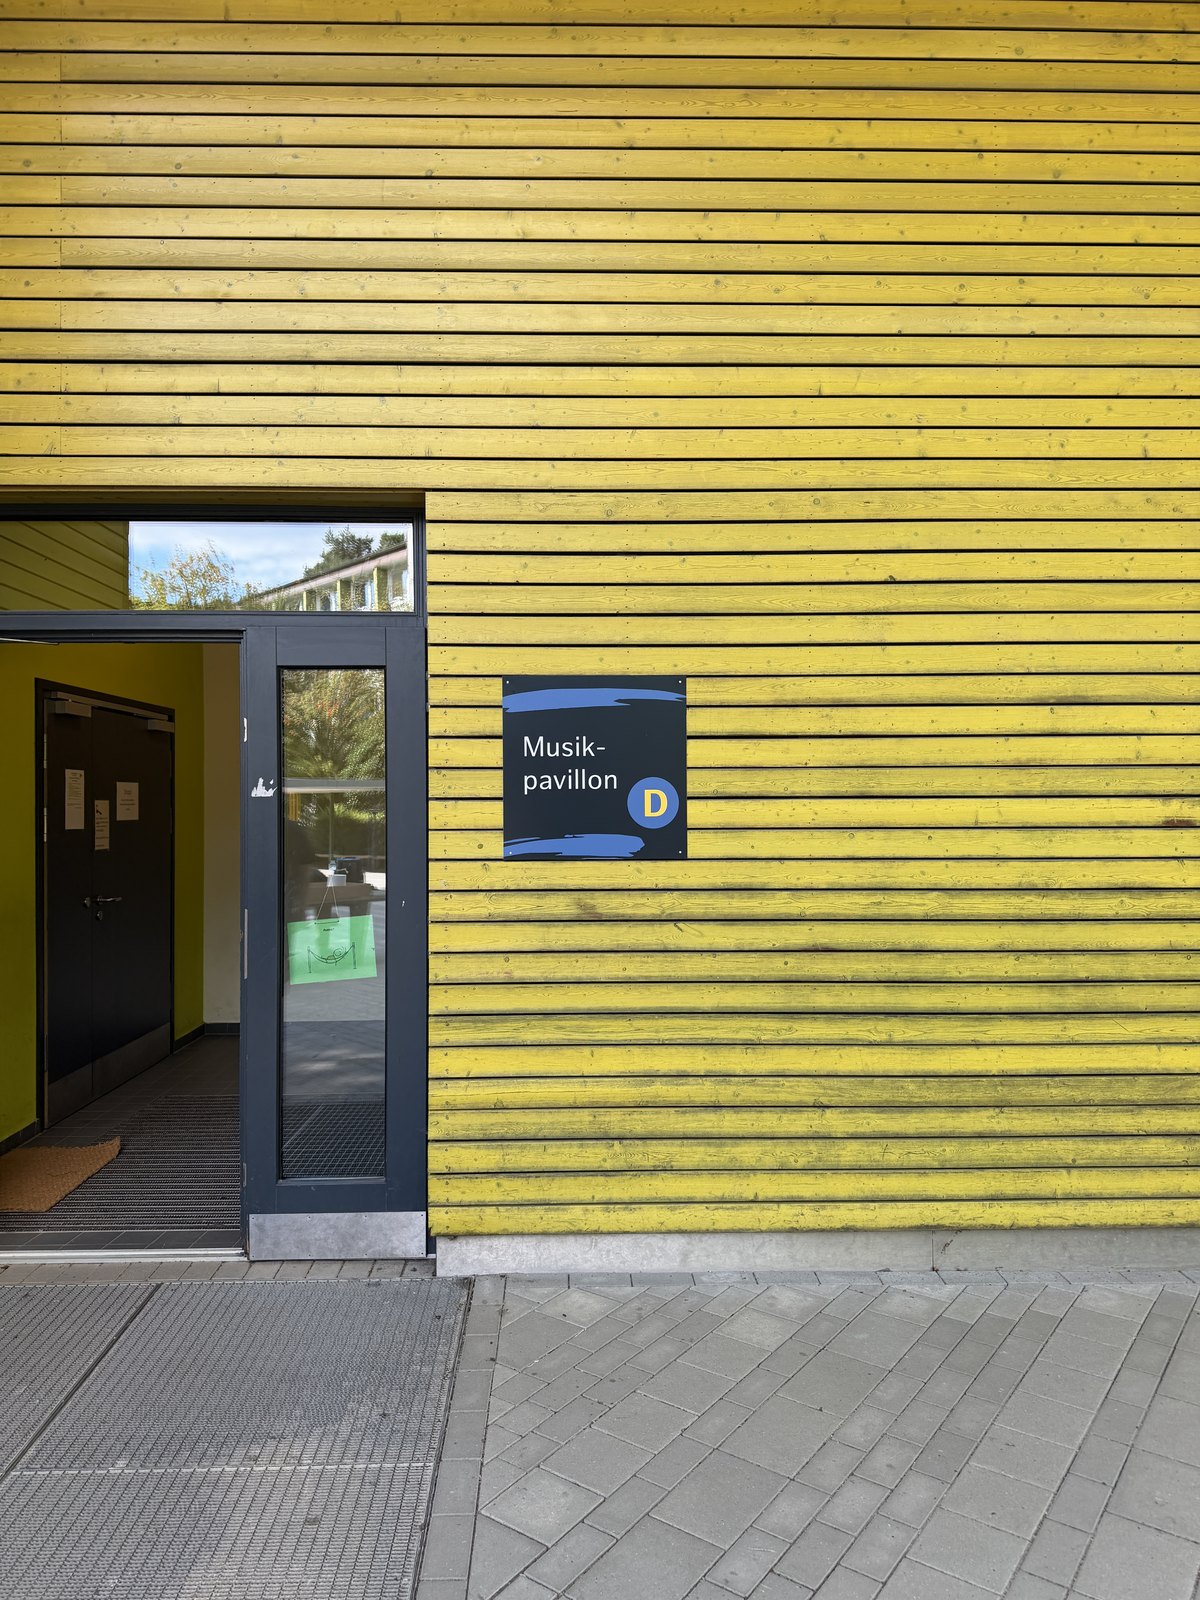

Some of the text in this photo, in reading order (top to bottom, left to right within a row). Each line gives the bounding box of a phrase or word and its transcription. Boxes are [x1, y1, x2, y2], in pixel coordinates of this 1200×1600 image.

[523, 735, 606, 757] Musik-
[523, 768, 618, 795] pavillon
[643, 789, 668, 818] D
